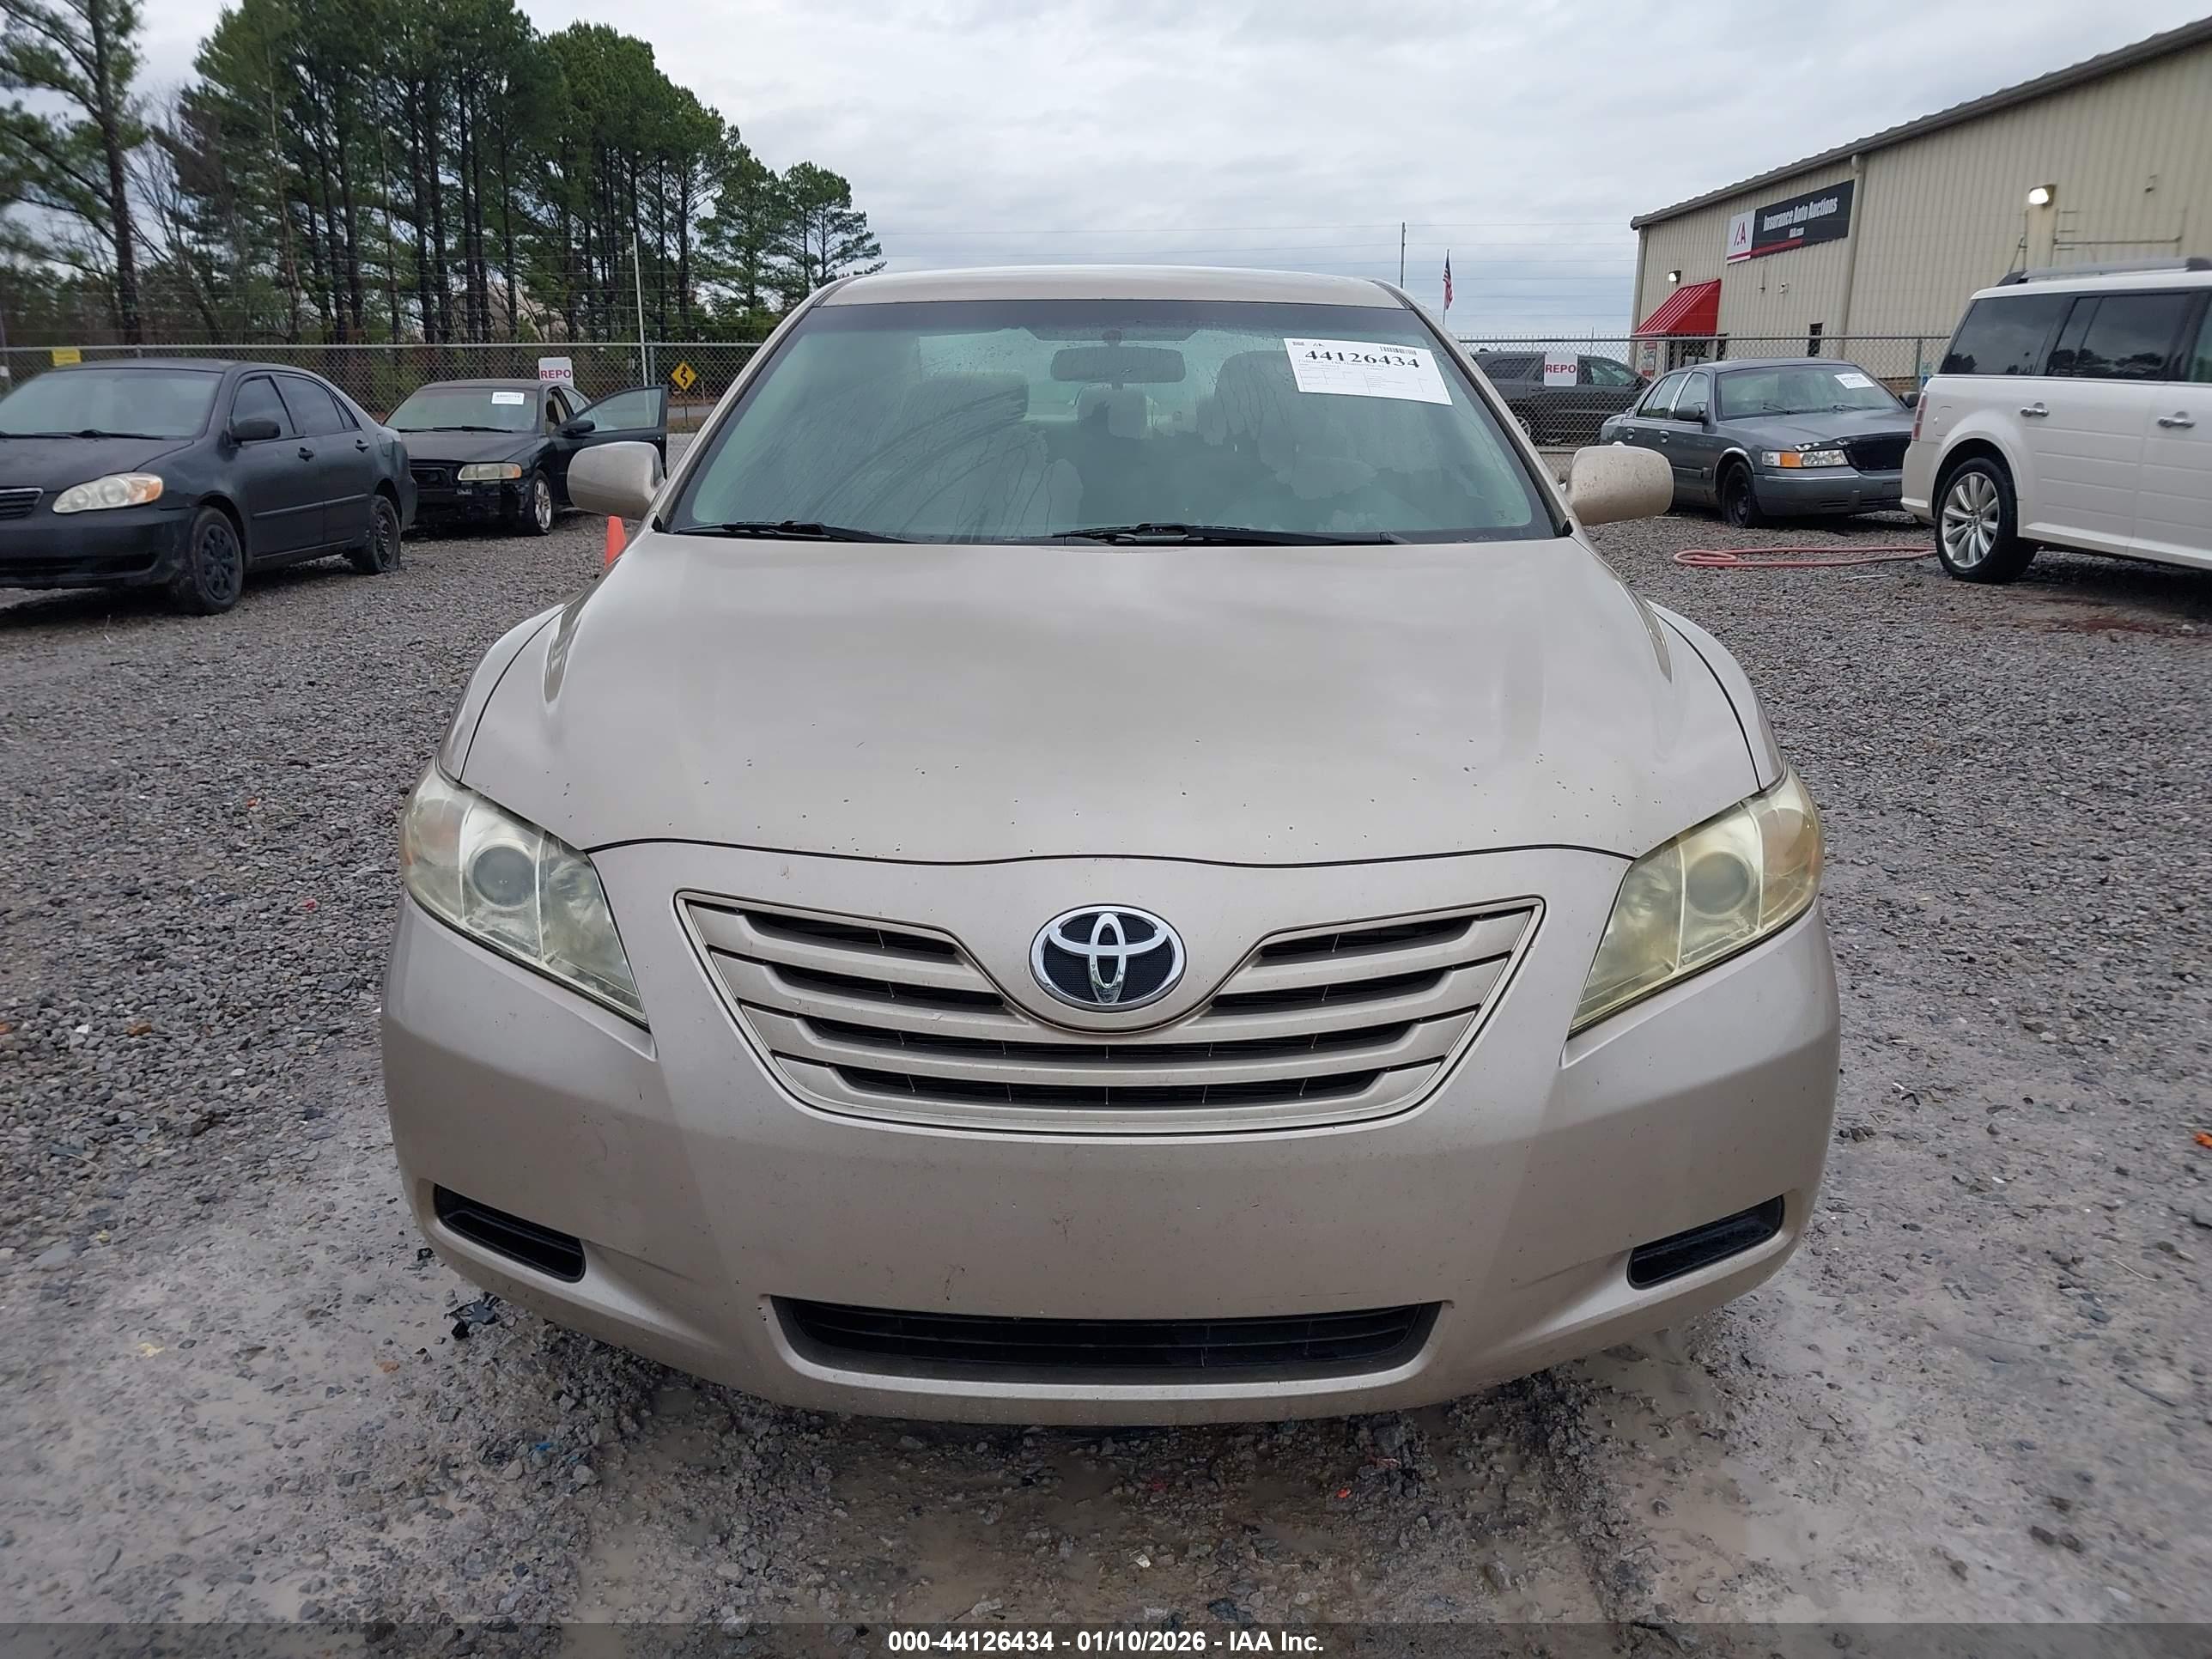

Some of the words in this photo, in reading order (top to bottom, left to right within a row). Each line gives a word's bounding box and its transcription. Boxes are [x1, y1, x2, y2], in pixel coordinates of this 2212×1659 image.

[1763, 210, 1793, 232] Insurance
[1793, 205, 1808, 223] Auto
[1808, 198, 1838, 220] Auctions
[1305, 350, 1419, 368] 44126434
[541, 369, 572, 379] REPO
[1546, 364, 1577, 374] REPO
